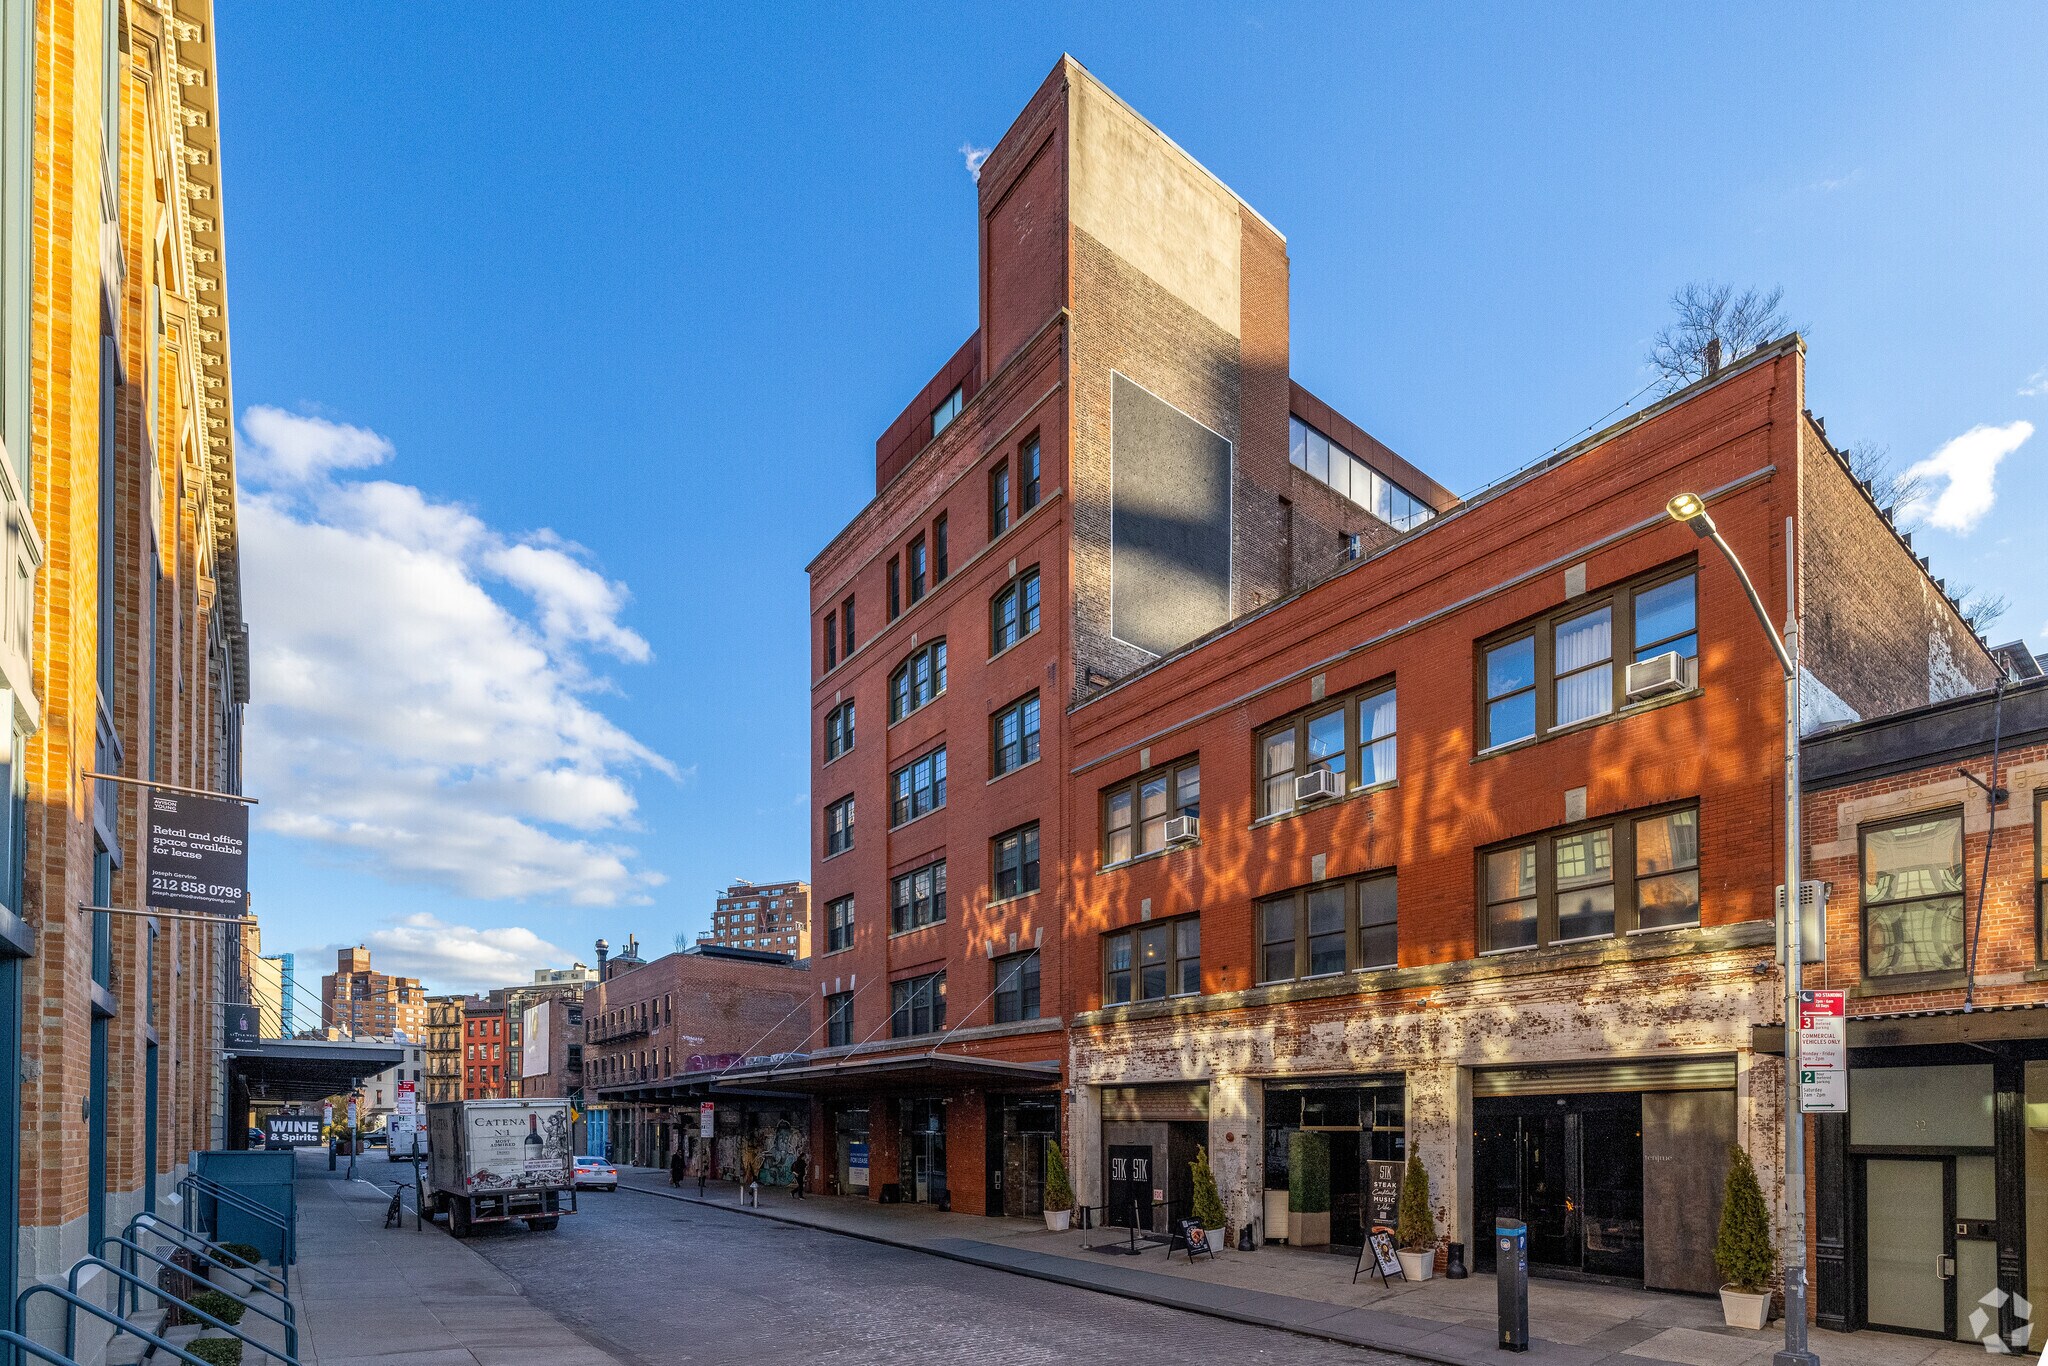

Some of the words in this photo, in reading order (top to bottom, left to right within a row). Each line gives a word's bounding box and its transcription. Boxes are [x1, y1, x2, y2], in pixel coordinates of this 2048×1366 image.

[153, 825, 186, 838] Retail
[189, 832, 210, 841] and
[213, 835, 243, 846] office
[153, 837, 187, 848] space
[190, 842, 242, 855] available
[153, 845, 169, 855] for
[172, 847, 202, 859] lease
[152, 878, 178, 890] 212
[181, 881, 206, 894] 858
[209, 885, 242, 898] 0798
[1804, 1018, 1811, 1028] 3
[1805, 1072, 1812, 1082] 2
[270, 1121, 319, 1132] WINE
[282, 1133, 317, 1142] Spirits
[1113, 1158, 1127, 1178] STK
[1133, 1158, 1148, 1180] STK
[1380, 1166, 1392, 1179] STK
